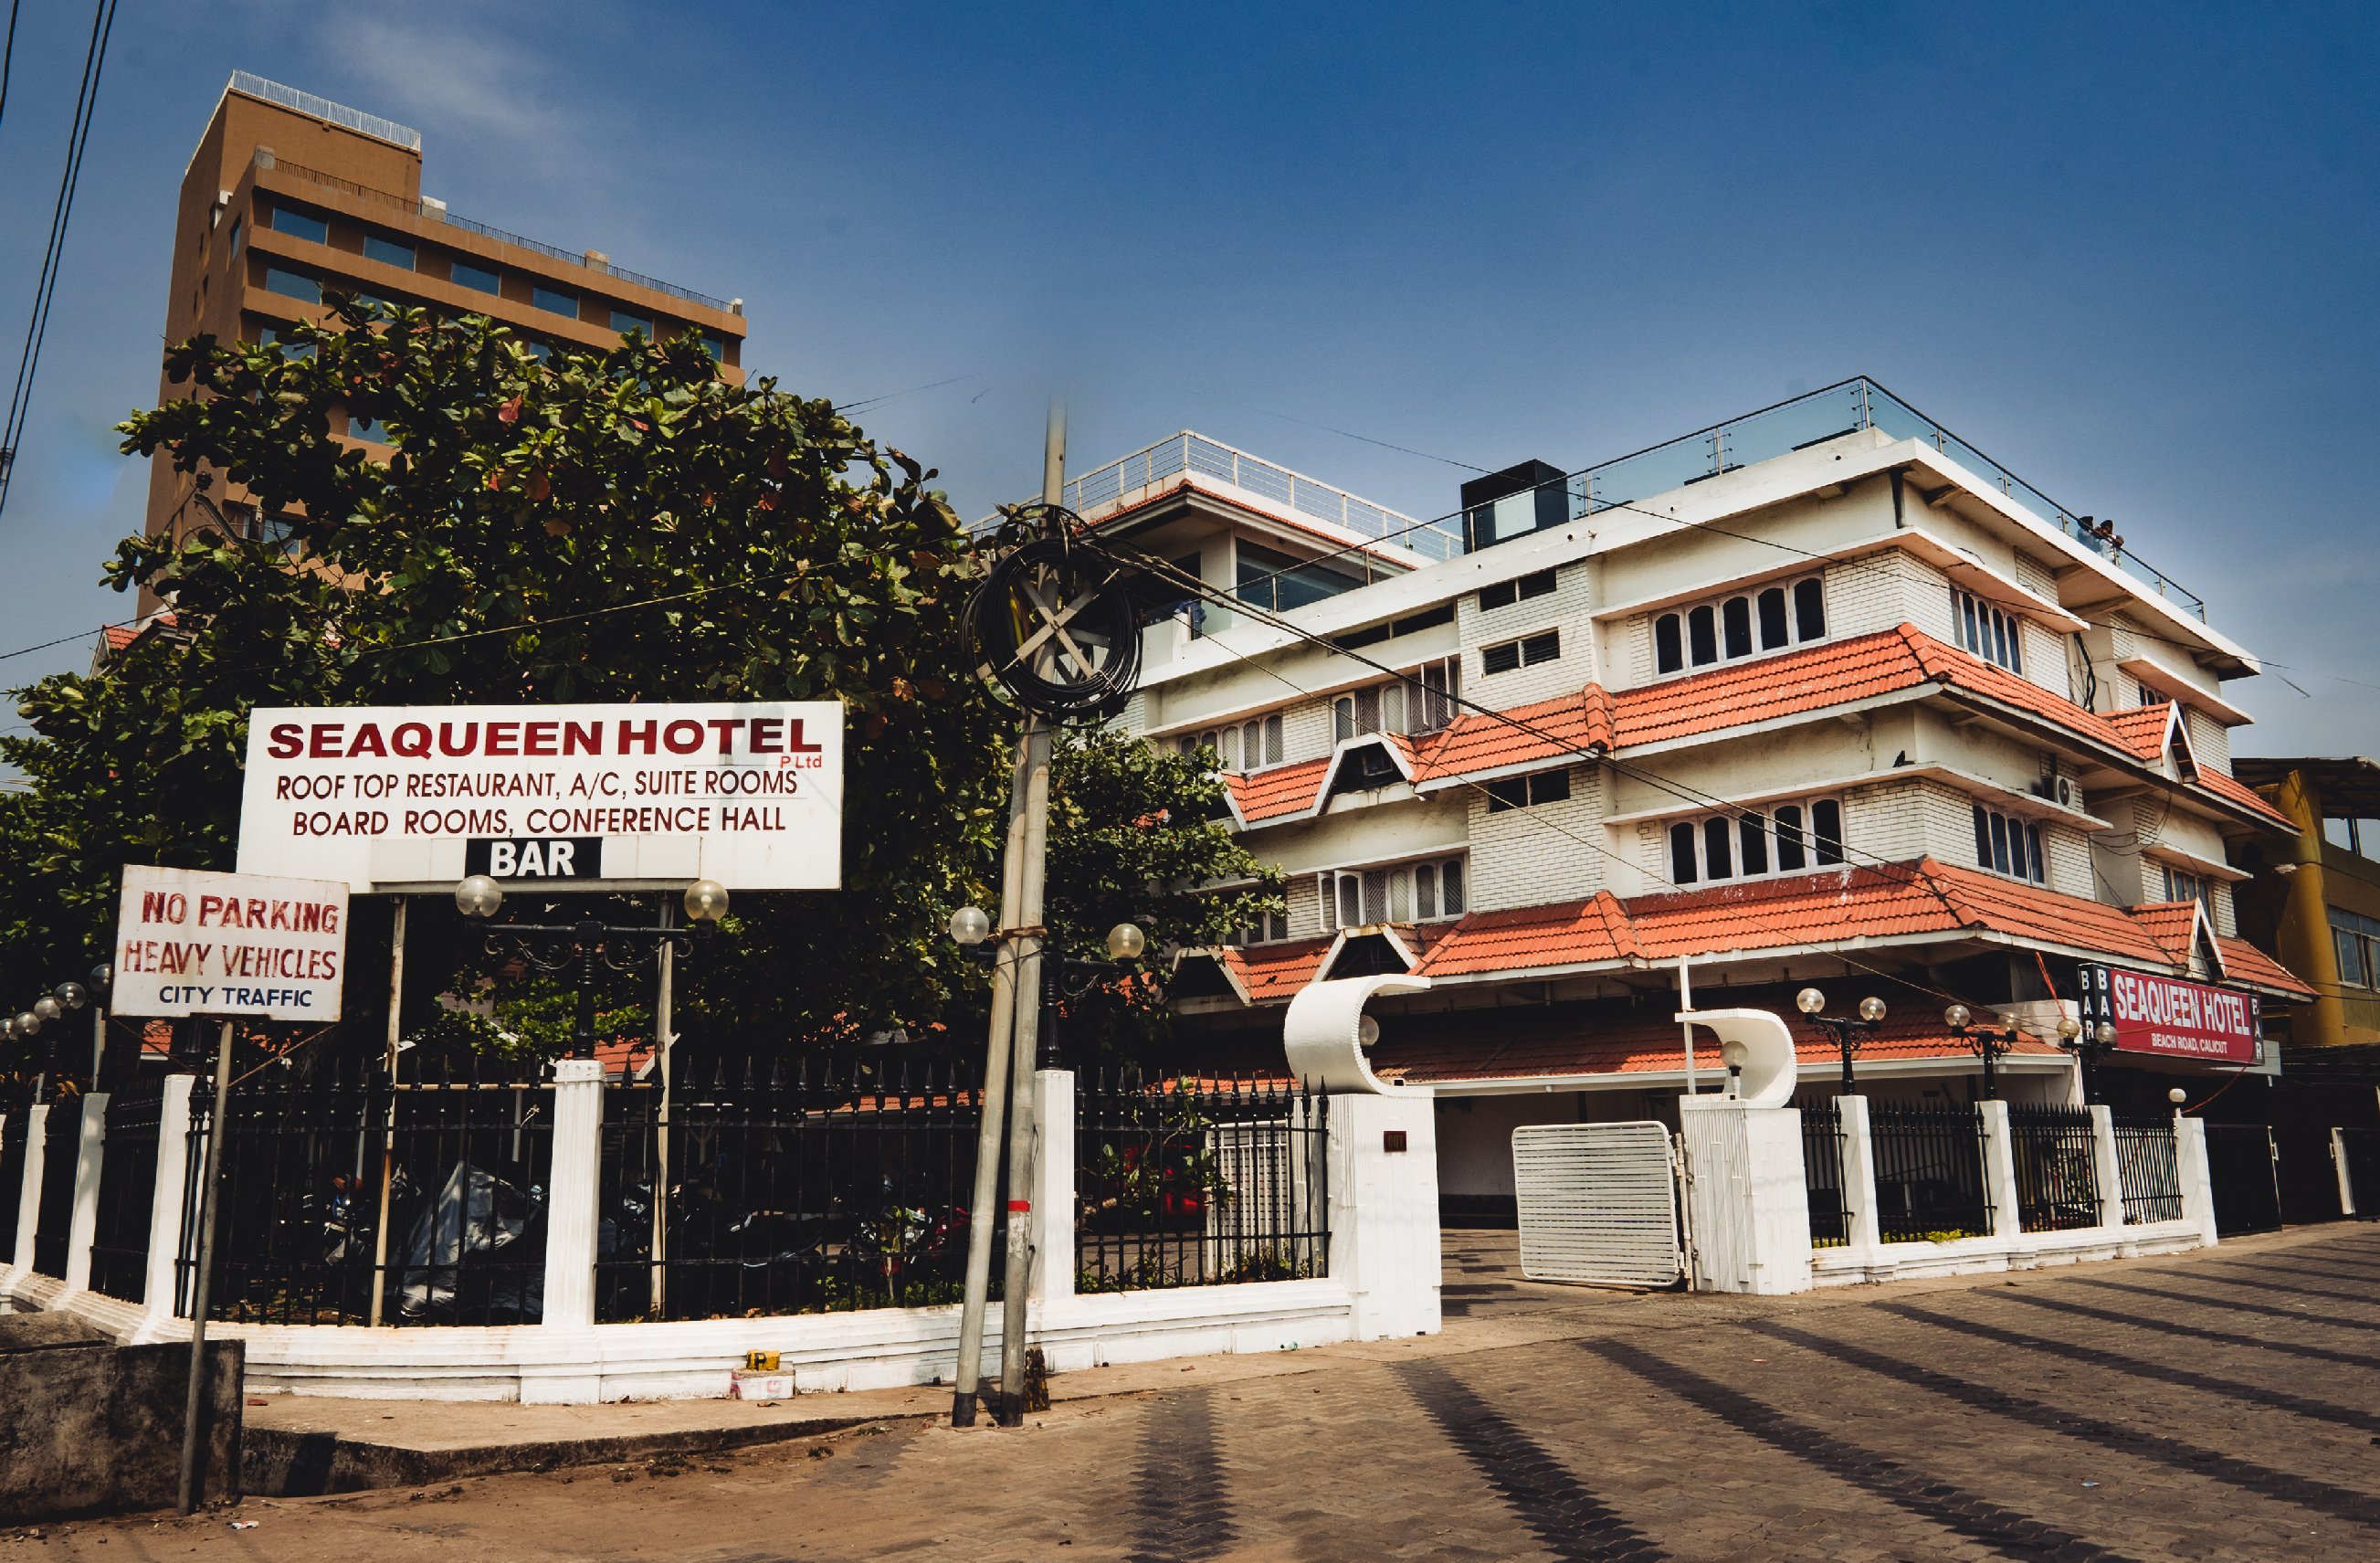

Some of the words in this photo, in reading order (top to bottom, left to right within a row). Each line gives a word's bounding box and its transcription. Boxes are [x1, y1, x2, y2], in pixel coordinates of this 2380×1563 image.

[268, 721, 603, 760] SEAQUEEN
[617, 718, 822, 755] HOTEL
[277, 775, 345, 800] ROOF
[353, 774, 398, 798] TOP
[406, 773, 561, 800] RESTAURANT,
[569, 772, 627, 800] A/C,
[635, 770, 697, 796] SUITE
[705, 770, 797, 795] ROOMS
[293, 811, 388, 836] BOARD
[405, 808, 513, 837] ROOMS,
[526, 807, 710, 834] CONFERENCE
[722, 807, 785, 831] HALL
[490, 840, 575, 877] BAR
[142, 891, 187, 924] NO
[198, 894, 339, 935] PARKING
[122, 940, 212, 976] HEAVY
[221, 944, 337, 981] VEHICLES
[159, 986, 215, 1004] CITY
[222, 987, 312, 1008] TRAFFIC
[2080, 970, 2094, 1040] BAR
[2097, 969, 2111, 1029] BA
[2114, 974, 2202, 1030] SEAQUEEN
[2203, 991, 2250, 1036] HOTEL
[2152, 1033, 2176, 1049] BEACH
[2177, 1036, 2199, 1053] ROAD,
[2199, 1039, 2227, 1053] CALICUT
[2251, 998, 2262, 1060] BAR
